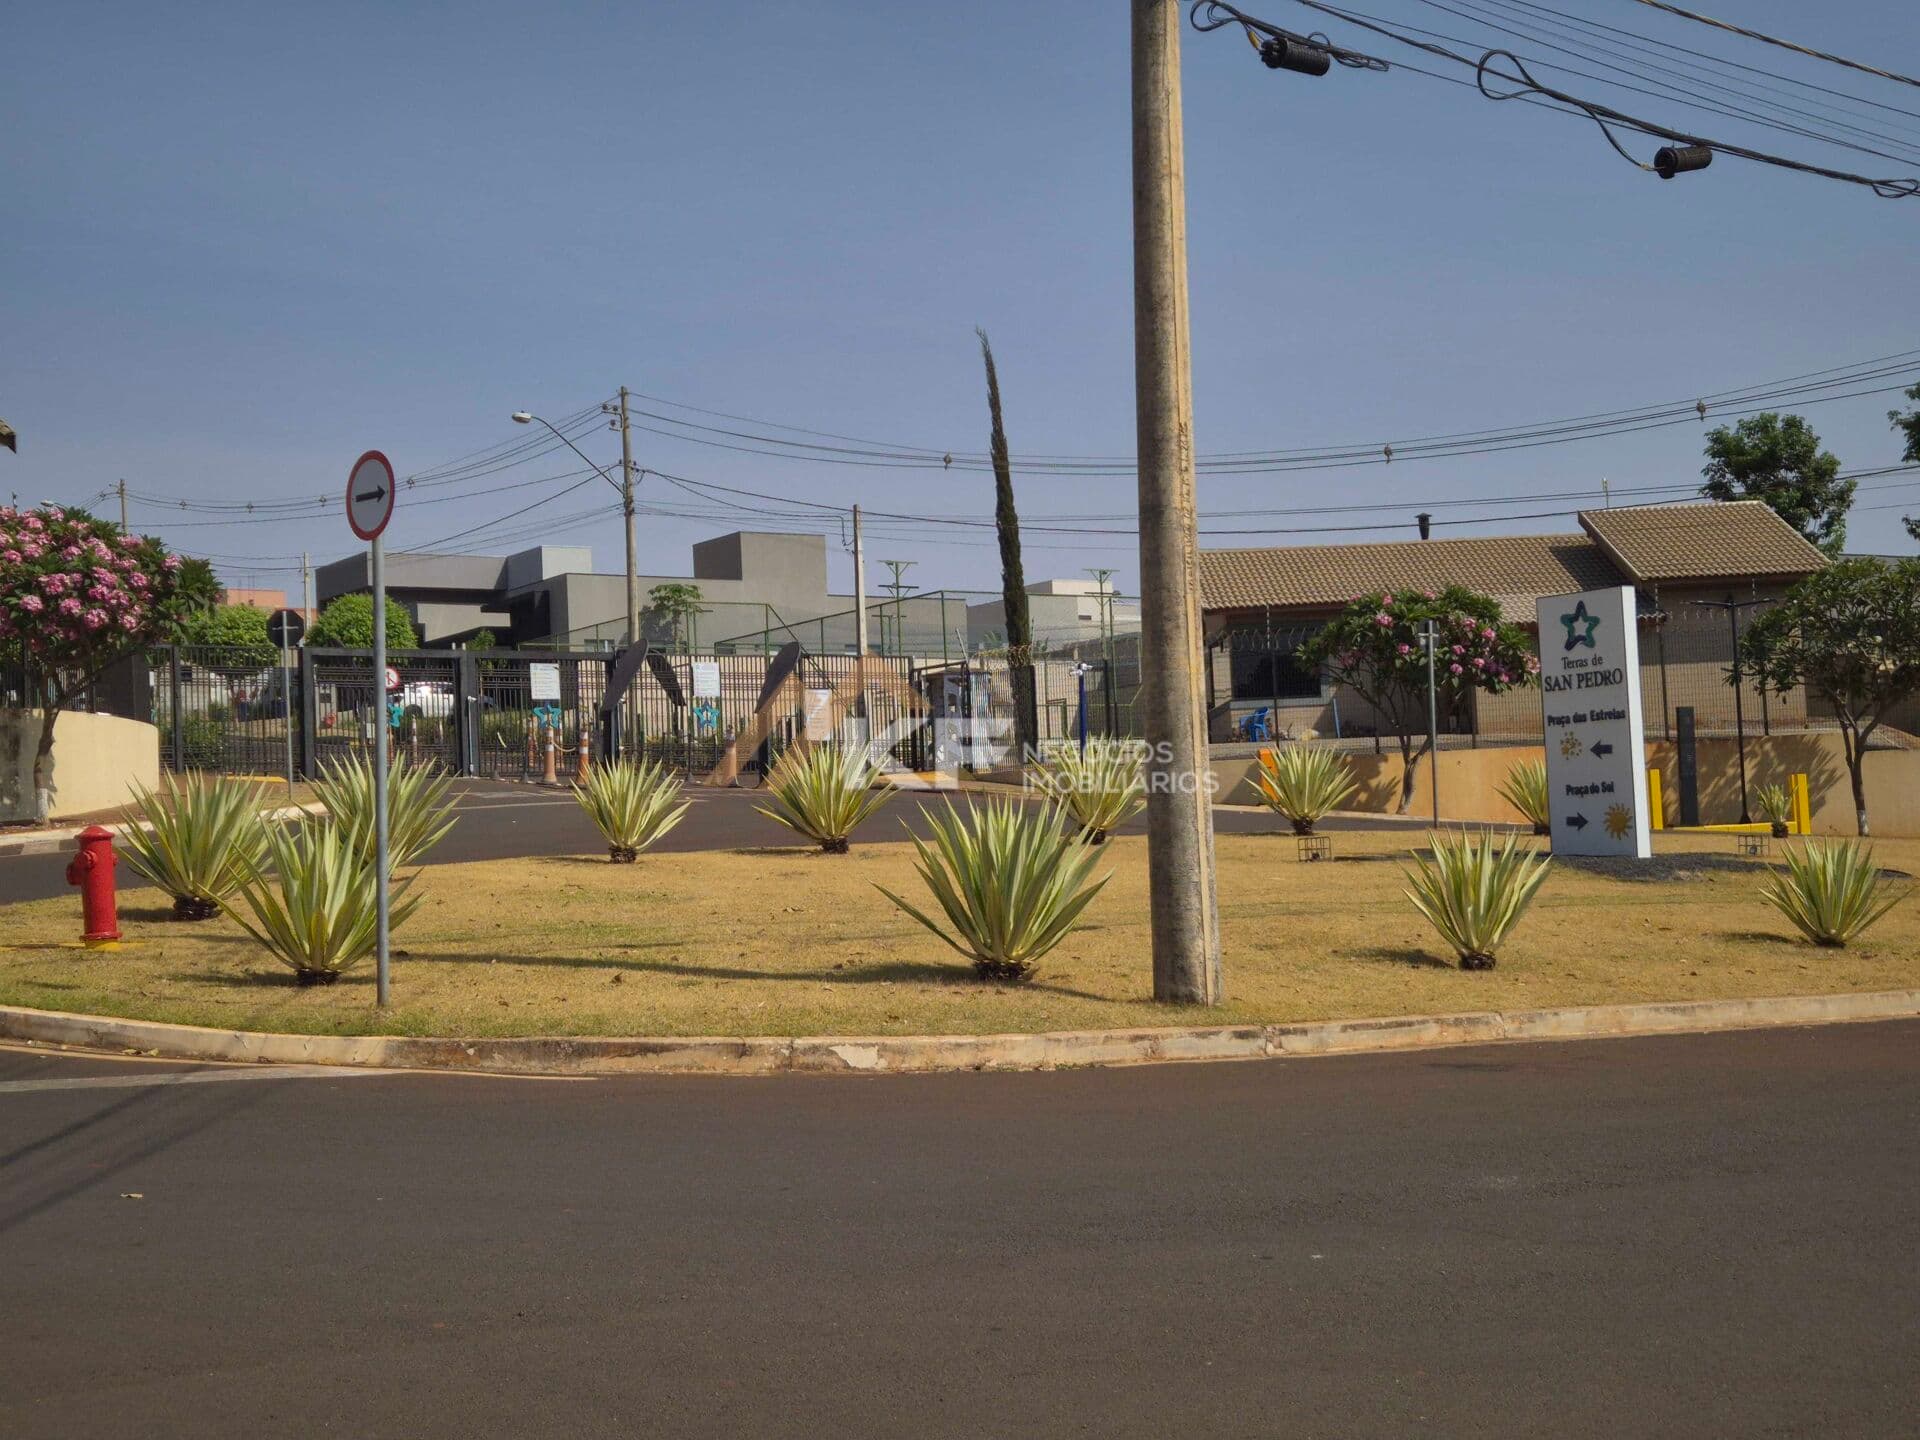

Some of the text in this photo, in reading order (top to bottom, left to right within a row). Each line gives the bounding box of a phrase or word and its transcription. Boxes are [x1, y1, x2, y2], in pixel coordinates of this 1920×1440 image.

[1561, 653, 1604, 670] Terras de
[1544, 668, 1623, 692] SAN PEDRO
[1547, 708, 1626, 728] Praça das Estrelas
[1565, 781, 1615, 798] Praça do Sol
